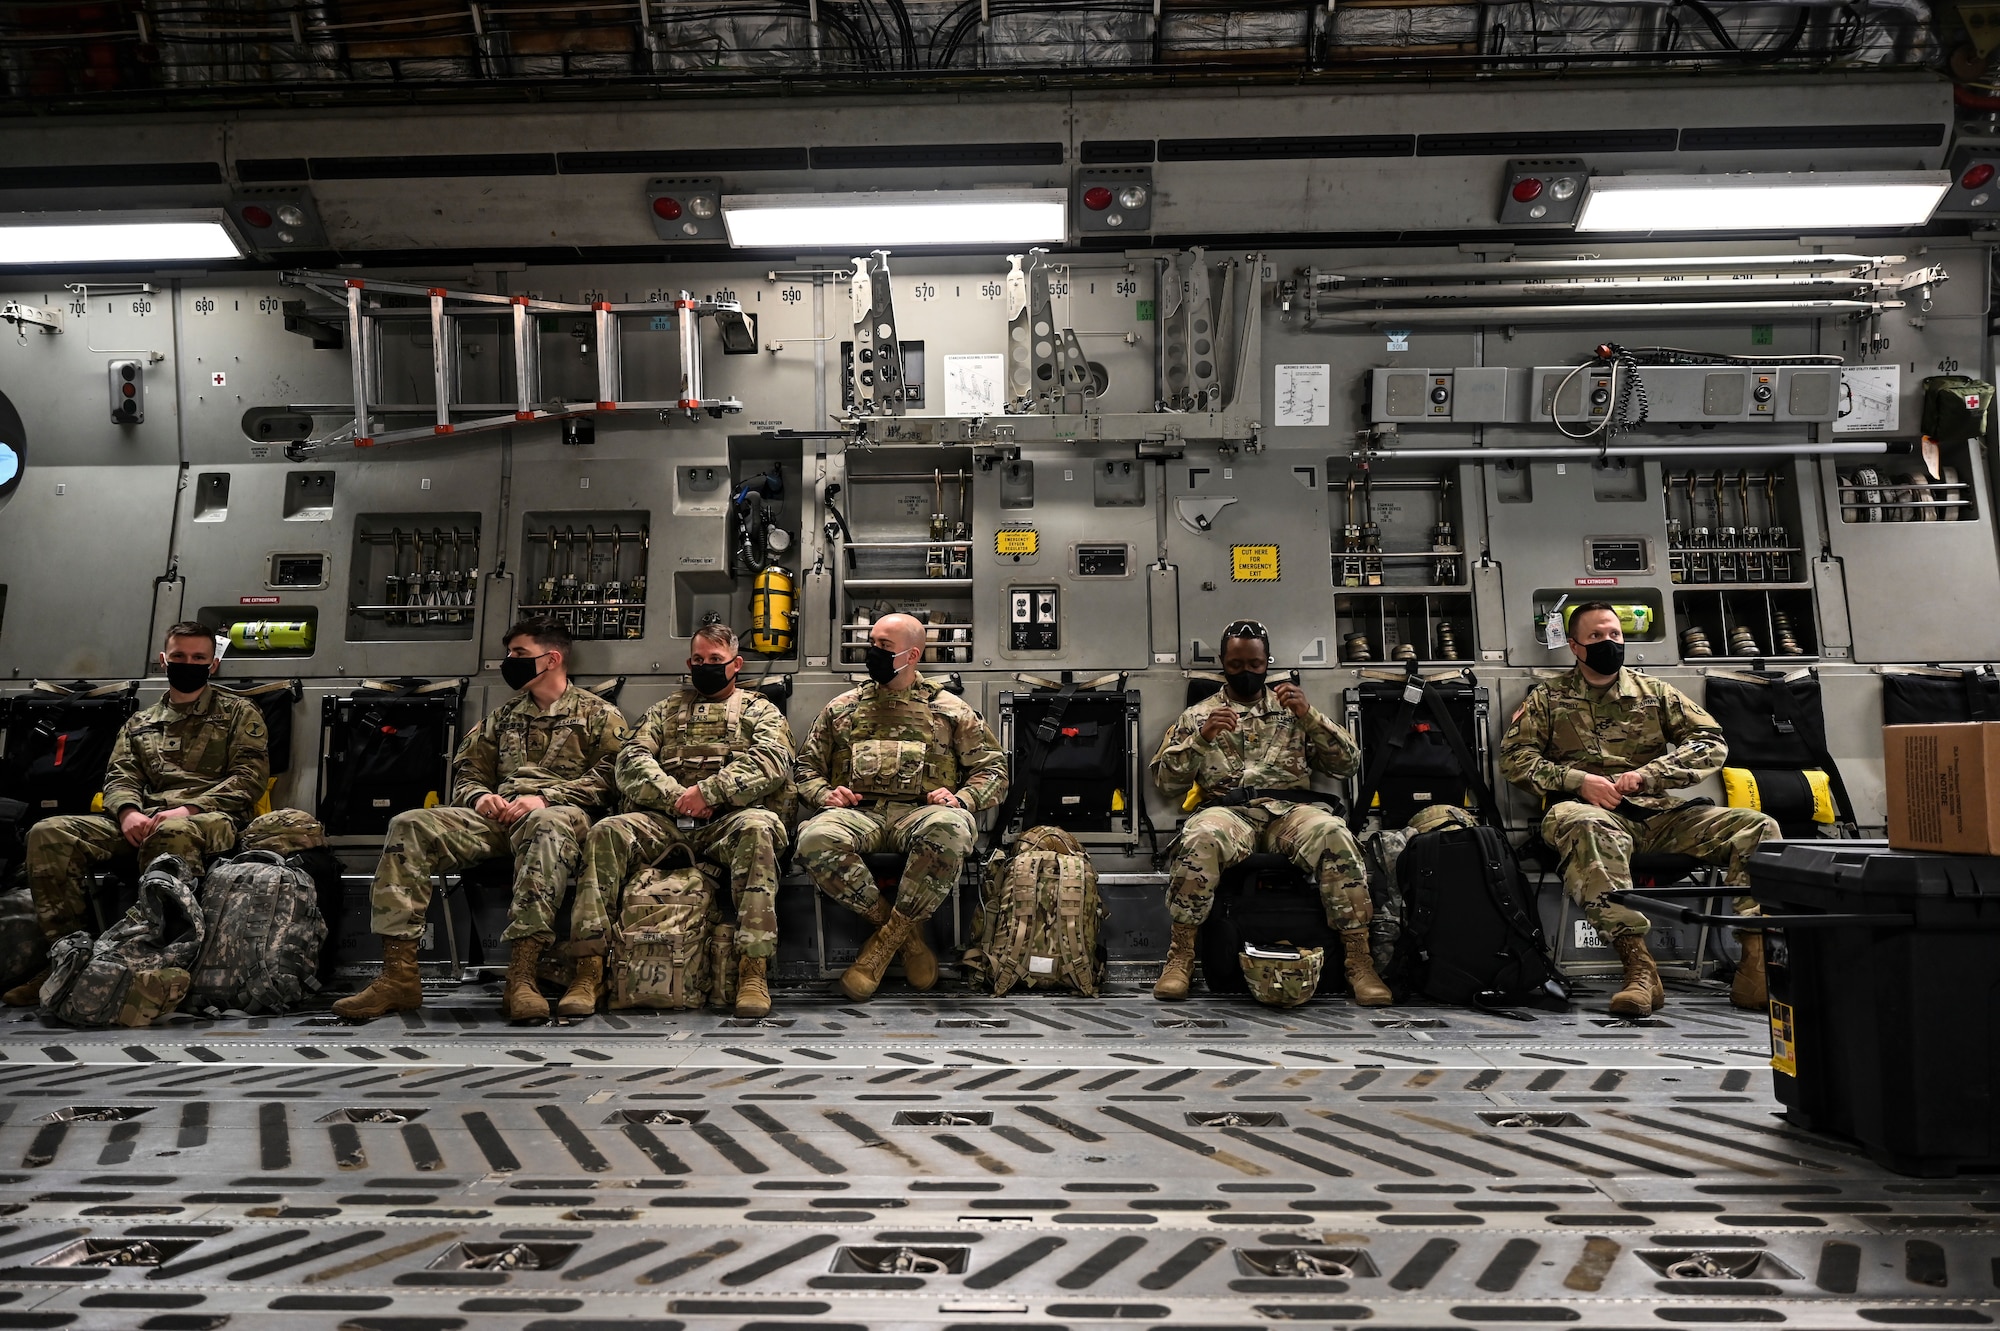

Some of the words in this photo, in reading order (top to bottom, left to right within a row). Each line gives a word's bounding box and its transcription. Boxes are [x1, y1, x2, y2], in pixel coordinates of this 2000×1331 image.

[915, 286, 934, 298] 570
[982, 285, 1001, 296] 560
[1049, 284, 1067, 295] 550
[1116, 283, 1136, 294] 540
[584, 293, 603, 304] 620
[716, 291, 735, 302] 600
[782, 290, 801, 301] 590
[132, 302, 151, 313] 690
[195, 301, 214, 312] 680
[259, 300, 278, 311] 670
[1938, 361, 1958, 372] 420
[1639, 699, 1657, 708] ARMY
[1940, 773, 1948, 807] NOTICE
[482, 939, 497, 948] 630
[1133, 937, 1149, 947] 540
[1583, 937, 1600, 946] 480
[1660, 937, 1676, 946] 470
[640, 964, 667, 983] US
